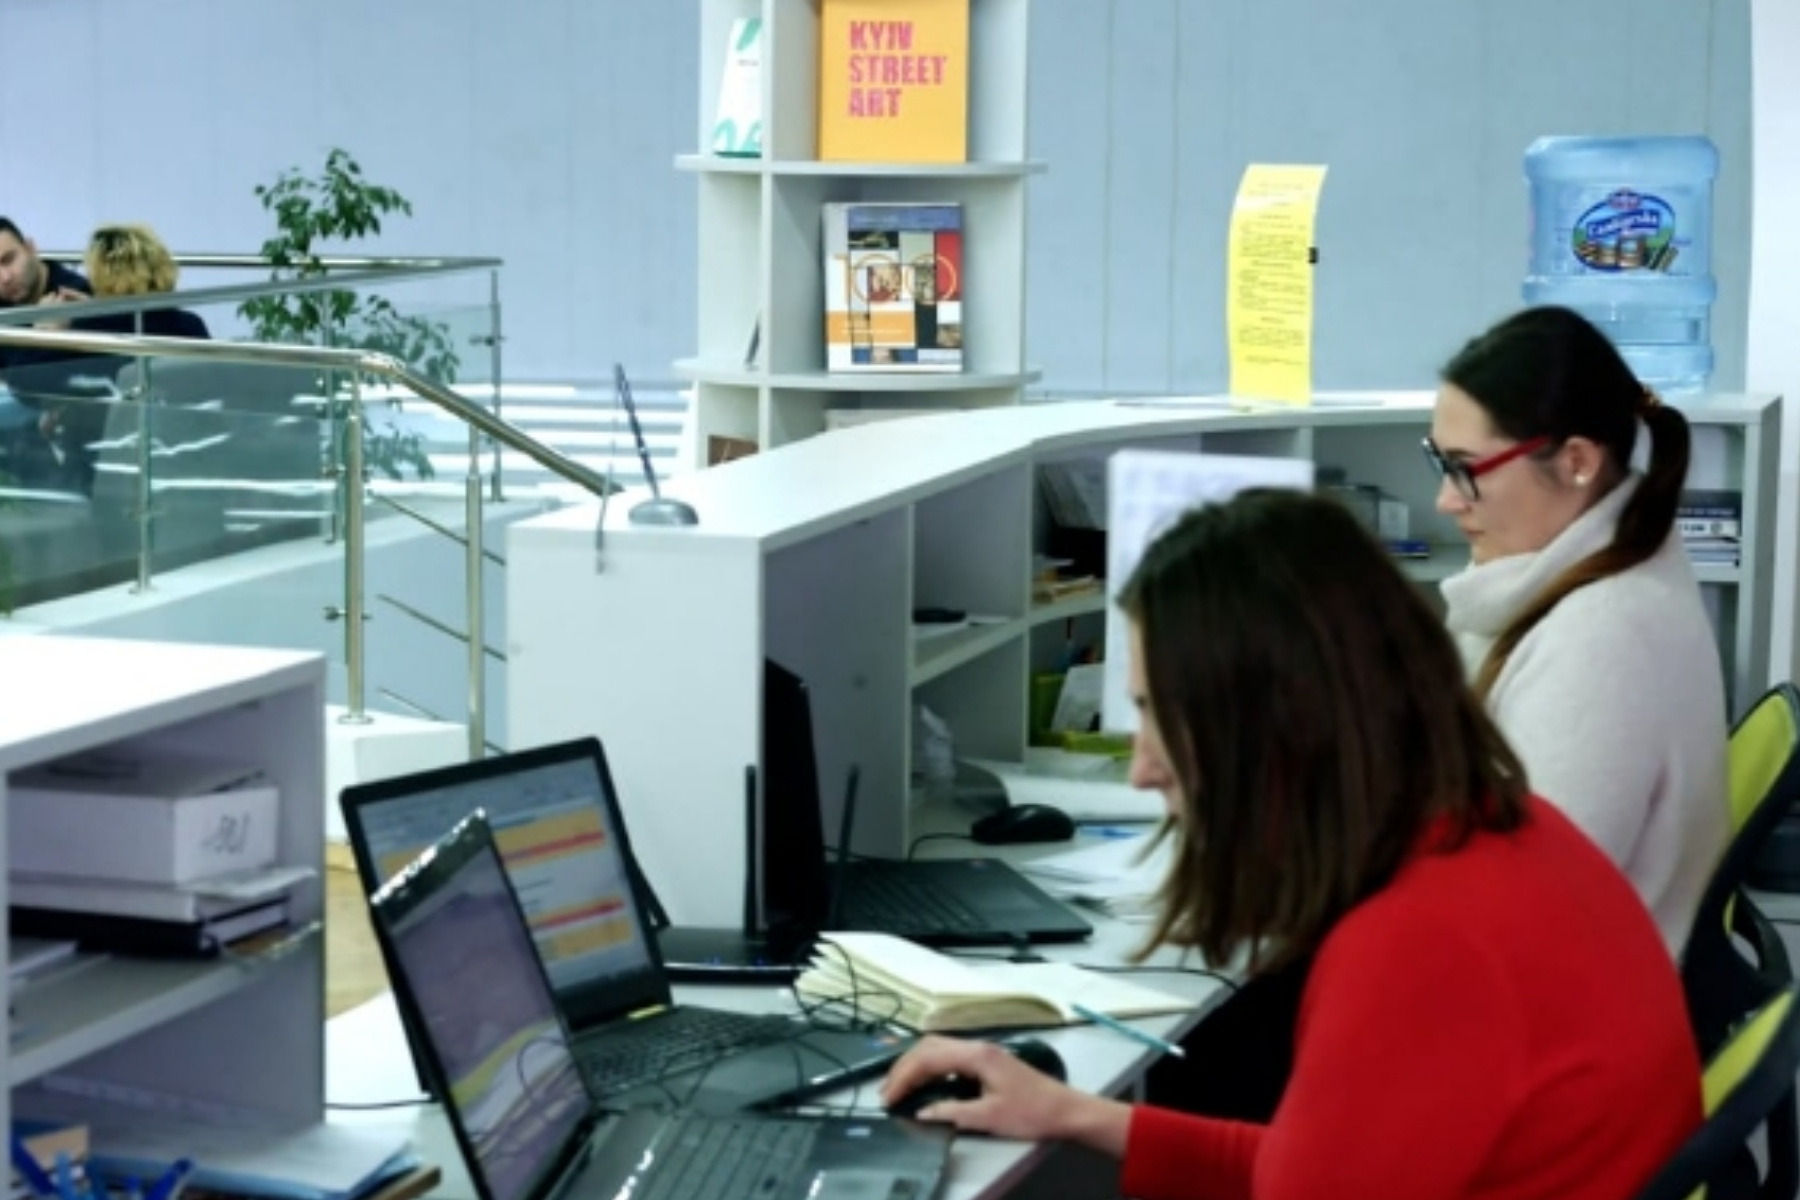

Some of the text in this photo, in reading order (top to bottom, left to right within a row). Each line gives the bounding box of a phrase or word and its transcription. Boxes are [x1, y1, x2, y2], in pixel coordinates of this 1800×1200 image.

[849, 20, 913, 50] KYIV
[849, 54, 947, 84] STREET
[849, 87, 902, 117] ART
